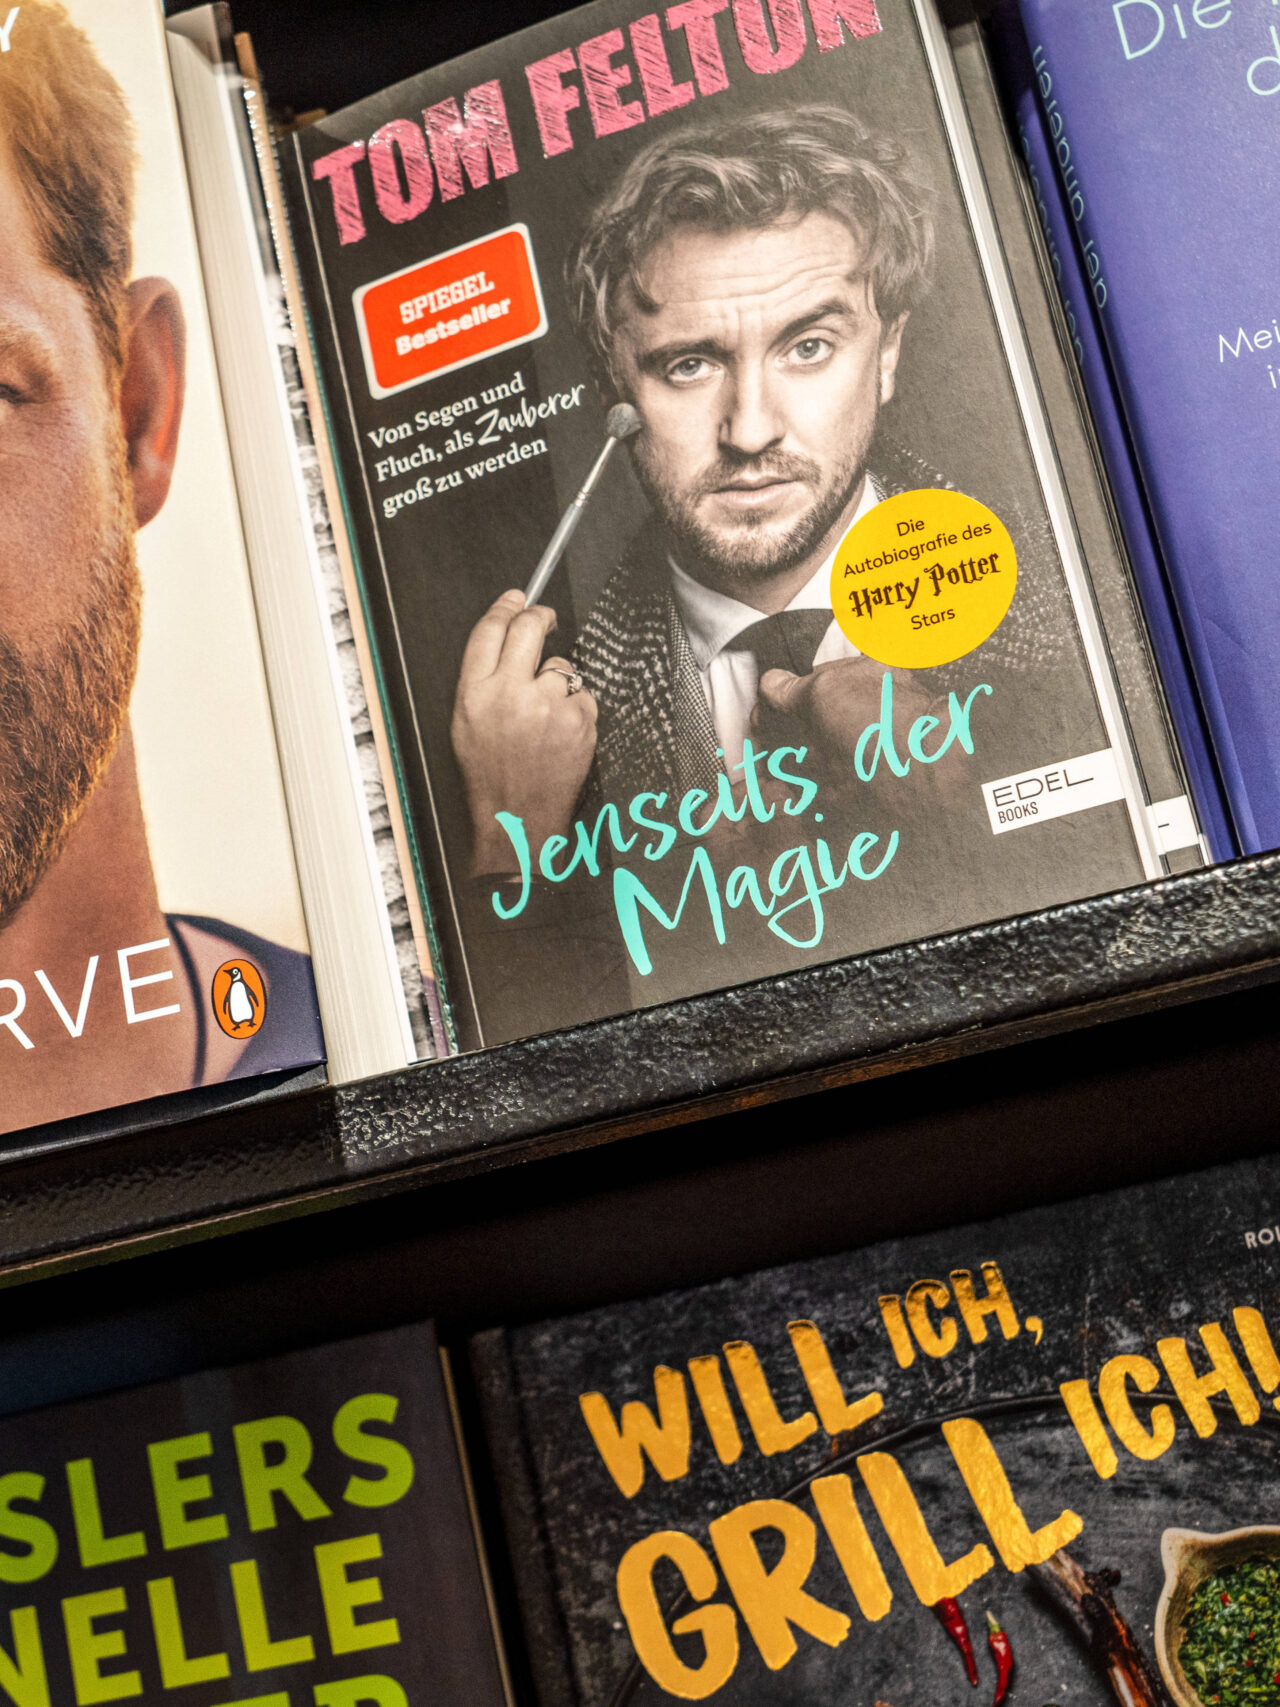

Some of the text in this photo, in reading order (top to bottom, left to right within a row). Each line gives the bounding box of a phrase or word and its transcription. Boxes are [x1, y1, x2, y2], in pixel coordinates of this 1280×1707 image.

[1112, 0, 1232, 60] Die
[313, 79, 519, 246] TOM
[395, 297, 511, 355] Bestseller
[399, 272, 494, 324] SPIEGEL
[368, 371, 526, 448] Von Segen und
[375, 384, 585, 482] Fluch, als Zauberer
[383, 438, 548, 518] groß zu werden
[844, 523, 992, 578] Autobiografie des
[896, 519, 925, 536] Die
[849, 552, 1001, 620] Harry Potter
[911, 608, 956, 630] Stars
[492, 672, 992, 919] Jenseits der
[992, 769, 1094, 807] EDEL
[998, 801, 1039, 824] BOOKS
[612, 812, 899, 975] Magie
[579, 1261, 1043, 1498] WILL ICH,
[617, 1417, 1083, 1700] GRILL
